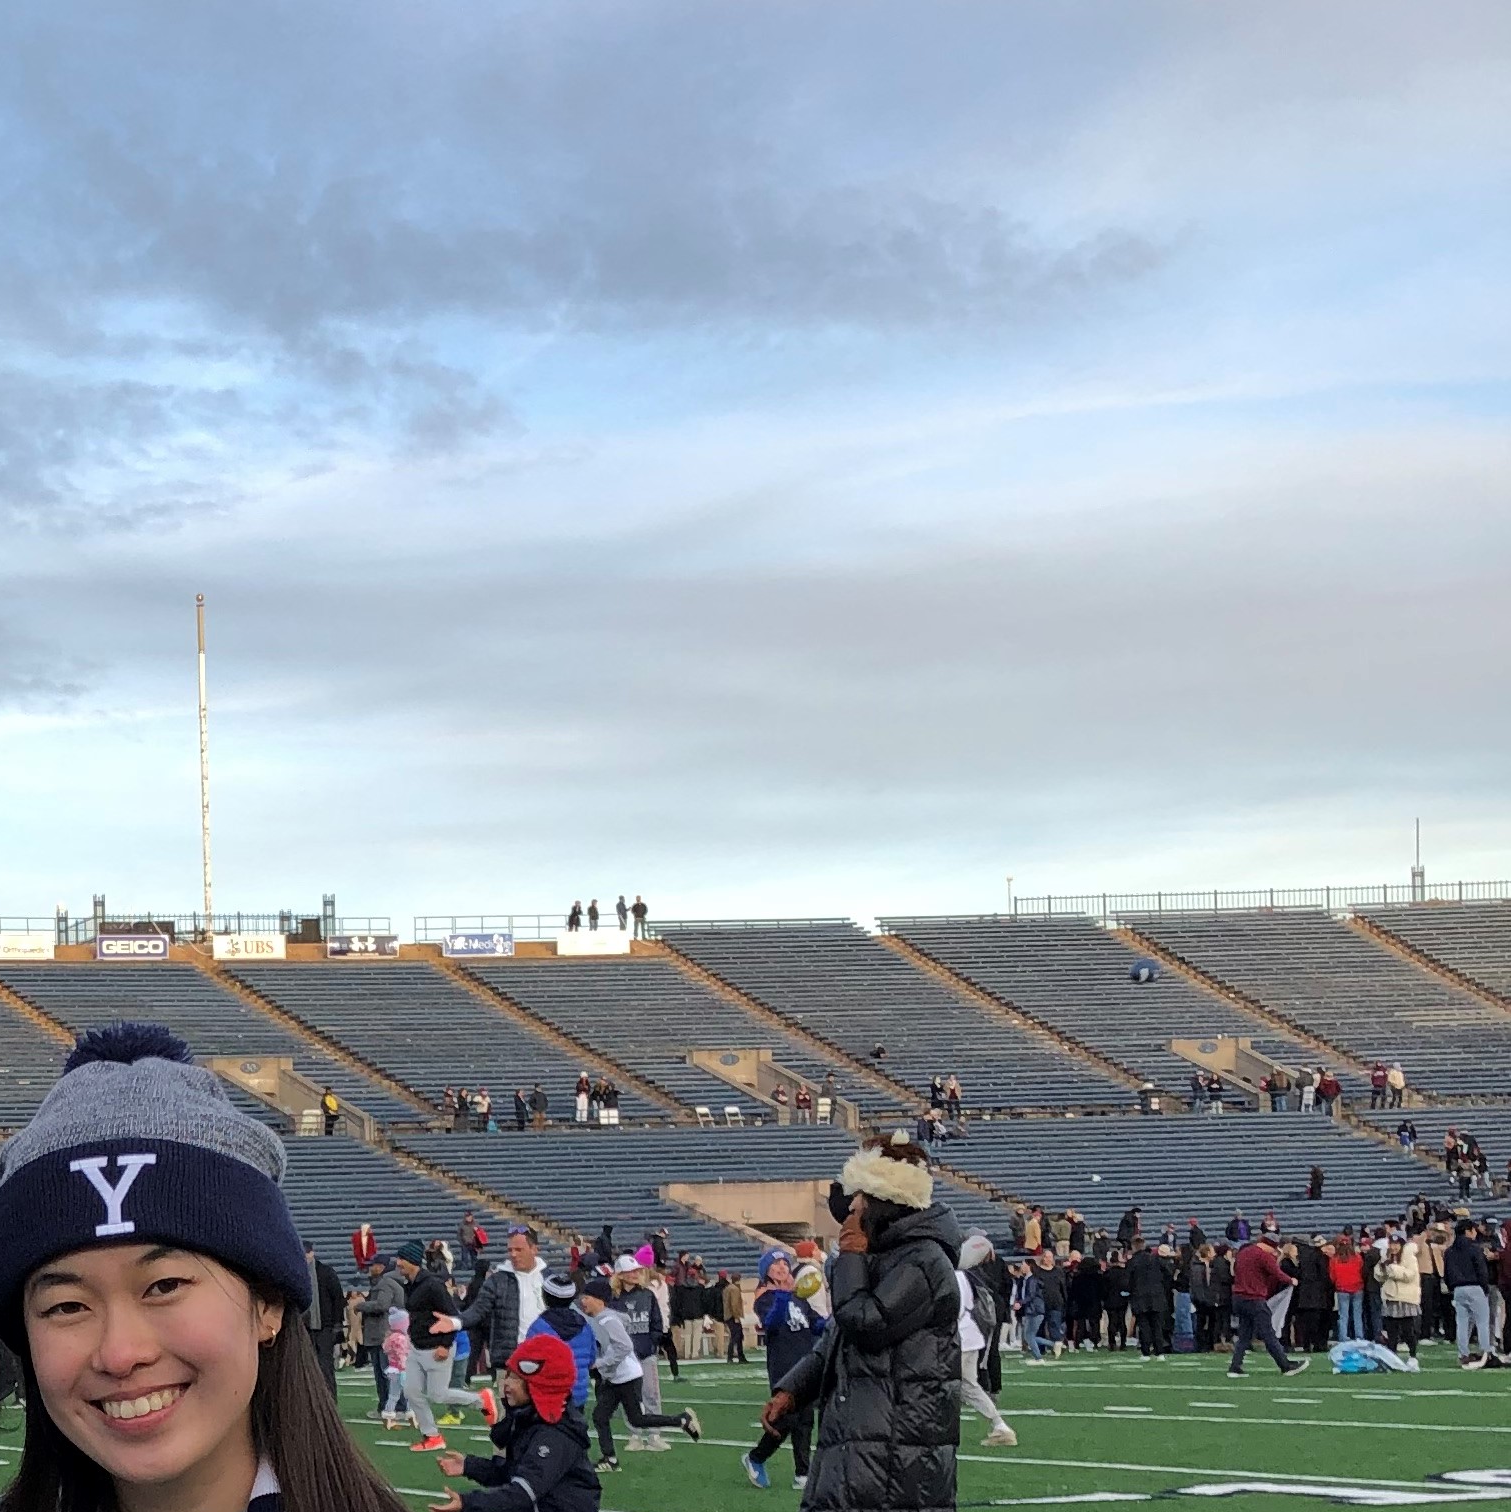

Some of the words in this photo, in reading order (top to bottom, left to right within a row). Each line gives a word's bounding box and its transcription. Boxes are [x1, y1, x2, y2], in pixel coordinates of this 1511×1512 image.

[102, 940, 164, 954] GEICO
[244, 940, 274, 954] UBS
[69, 1153, 157, 1237] Y
